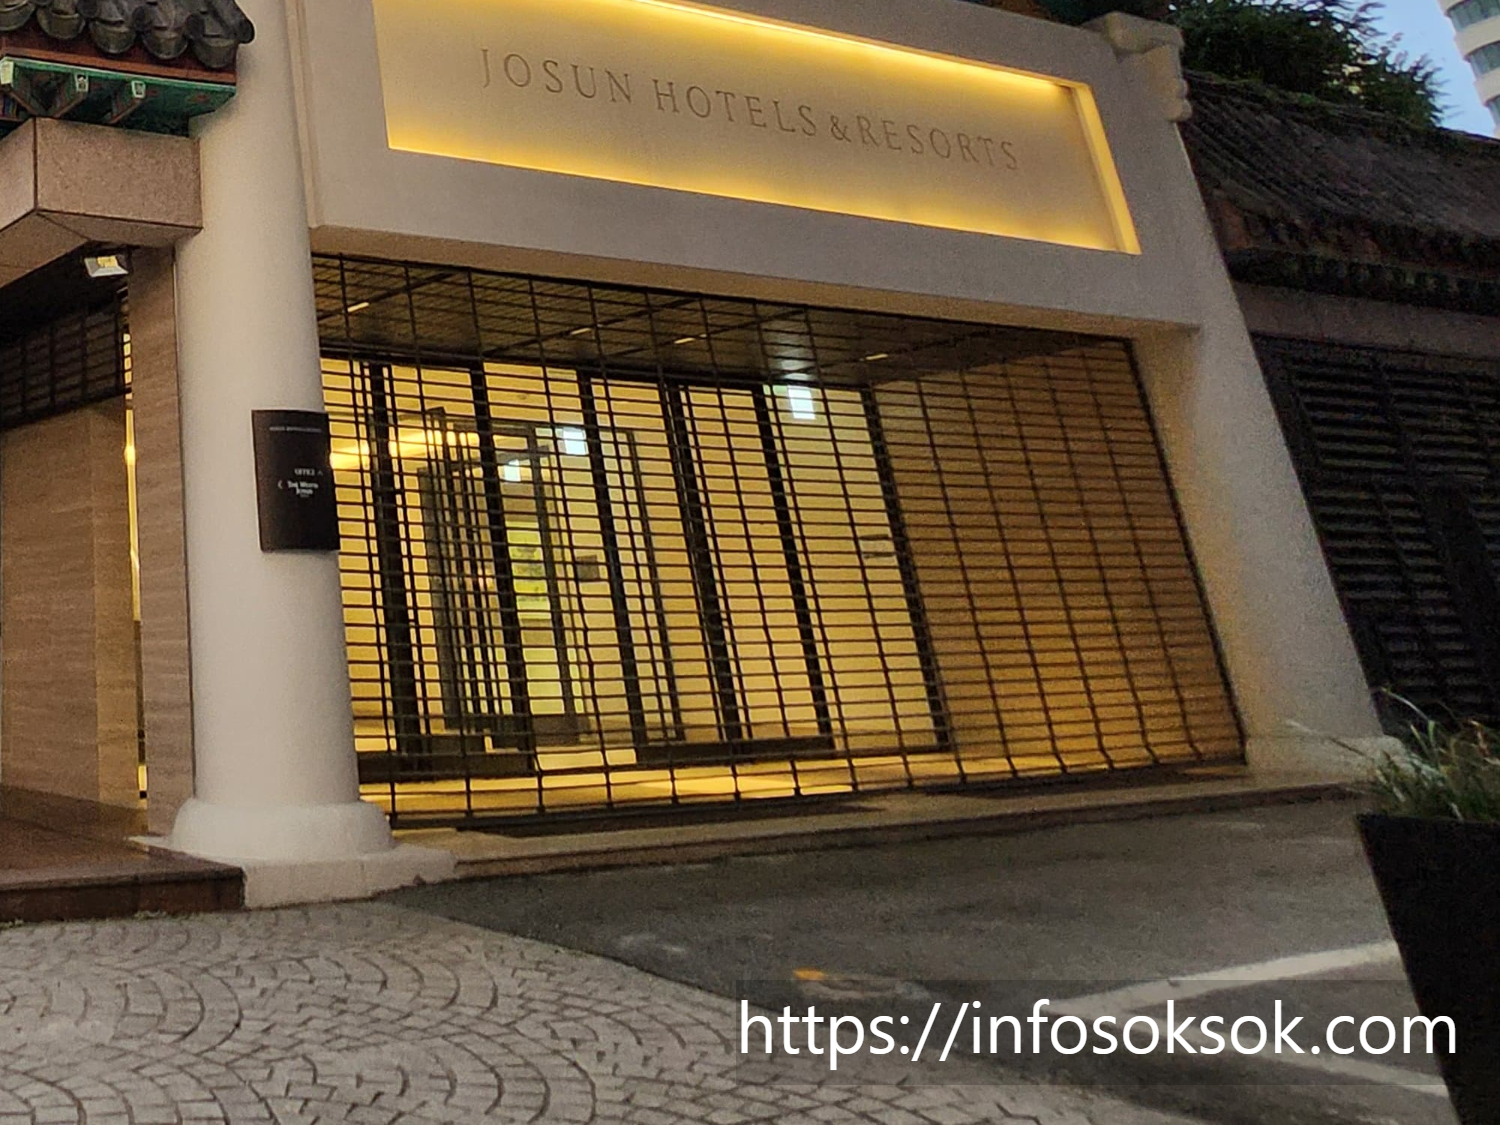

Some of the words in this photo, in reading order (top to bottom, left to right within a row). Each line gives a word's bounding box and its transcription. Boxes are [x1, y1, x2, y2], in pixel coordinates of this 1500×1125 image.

[478, 47, 634, 104] JOSUN
[651, 77, 819, 138] HOTELS
[856, 114, 1019, 172] RESORTS
